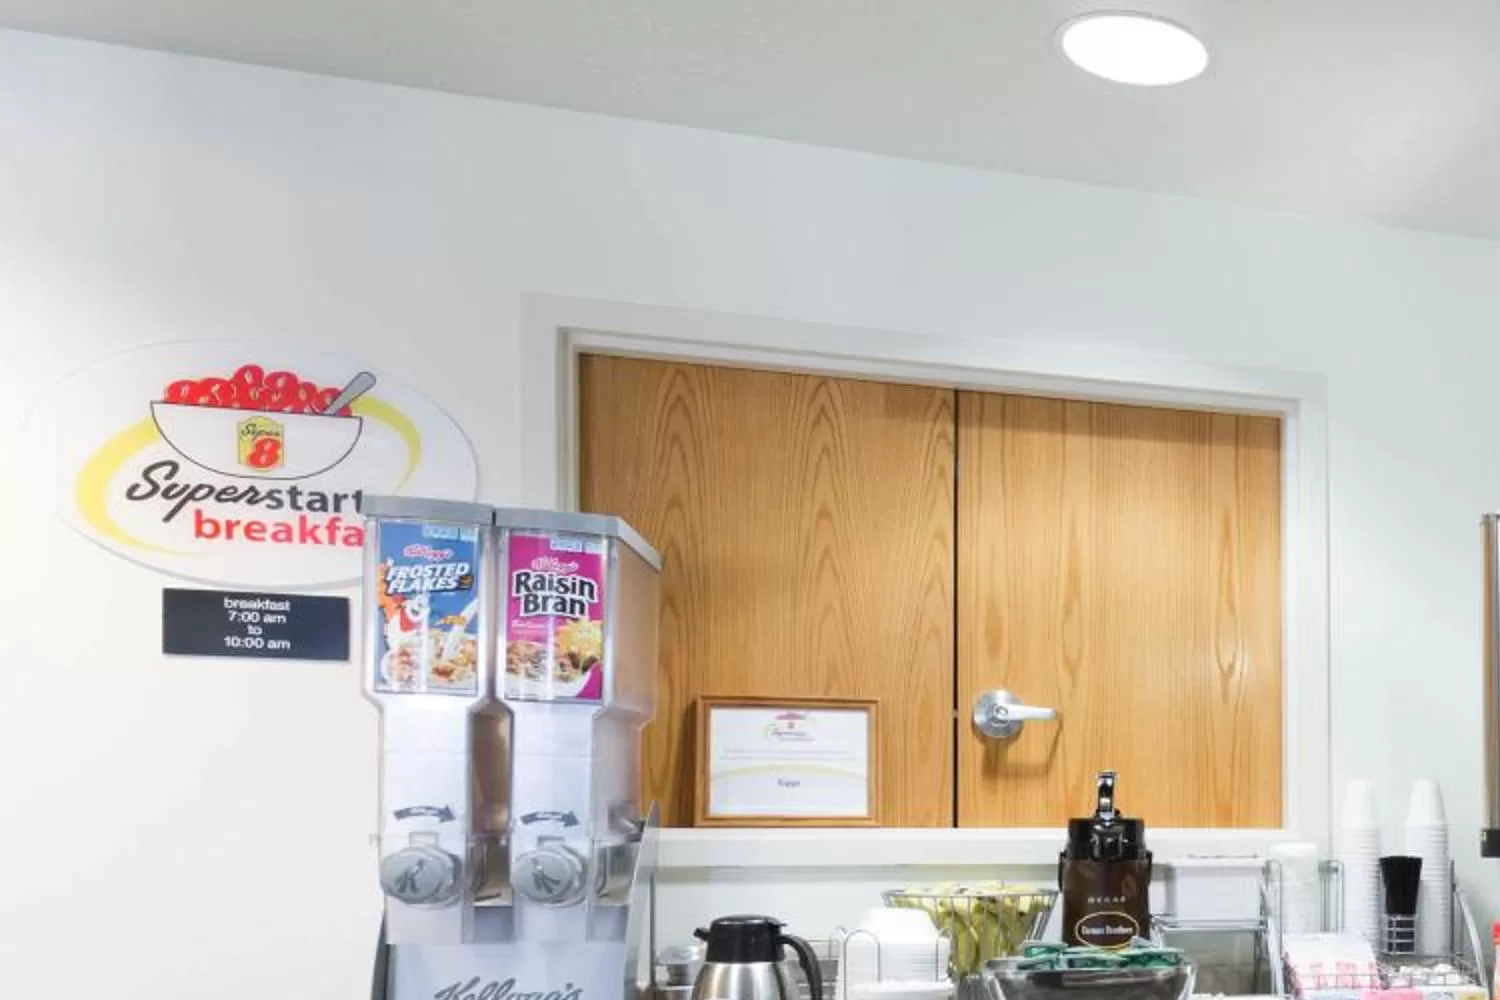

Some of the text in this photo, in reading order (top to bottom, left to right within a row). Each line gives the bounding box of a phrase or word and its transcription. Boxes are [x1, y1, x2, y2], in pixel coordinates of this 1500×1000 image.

[246, 436, 282, 469] 8
[193, 509, 365, 548] breakfa
[387, 562, 470, 581] FROSTED
[387, 578, 458, 594] FLAKES
[513, 571, 597, 601] Raisin
[224, 597, 291, 612] breakfast
[522, 593, 587, 616] Bran
[228, 611, 287, 624] 7:00 am
[247, 624, 263, 635] to
[224, 636, 291, 650] 10:00 am
